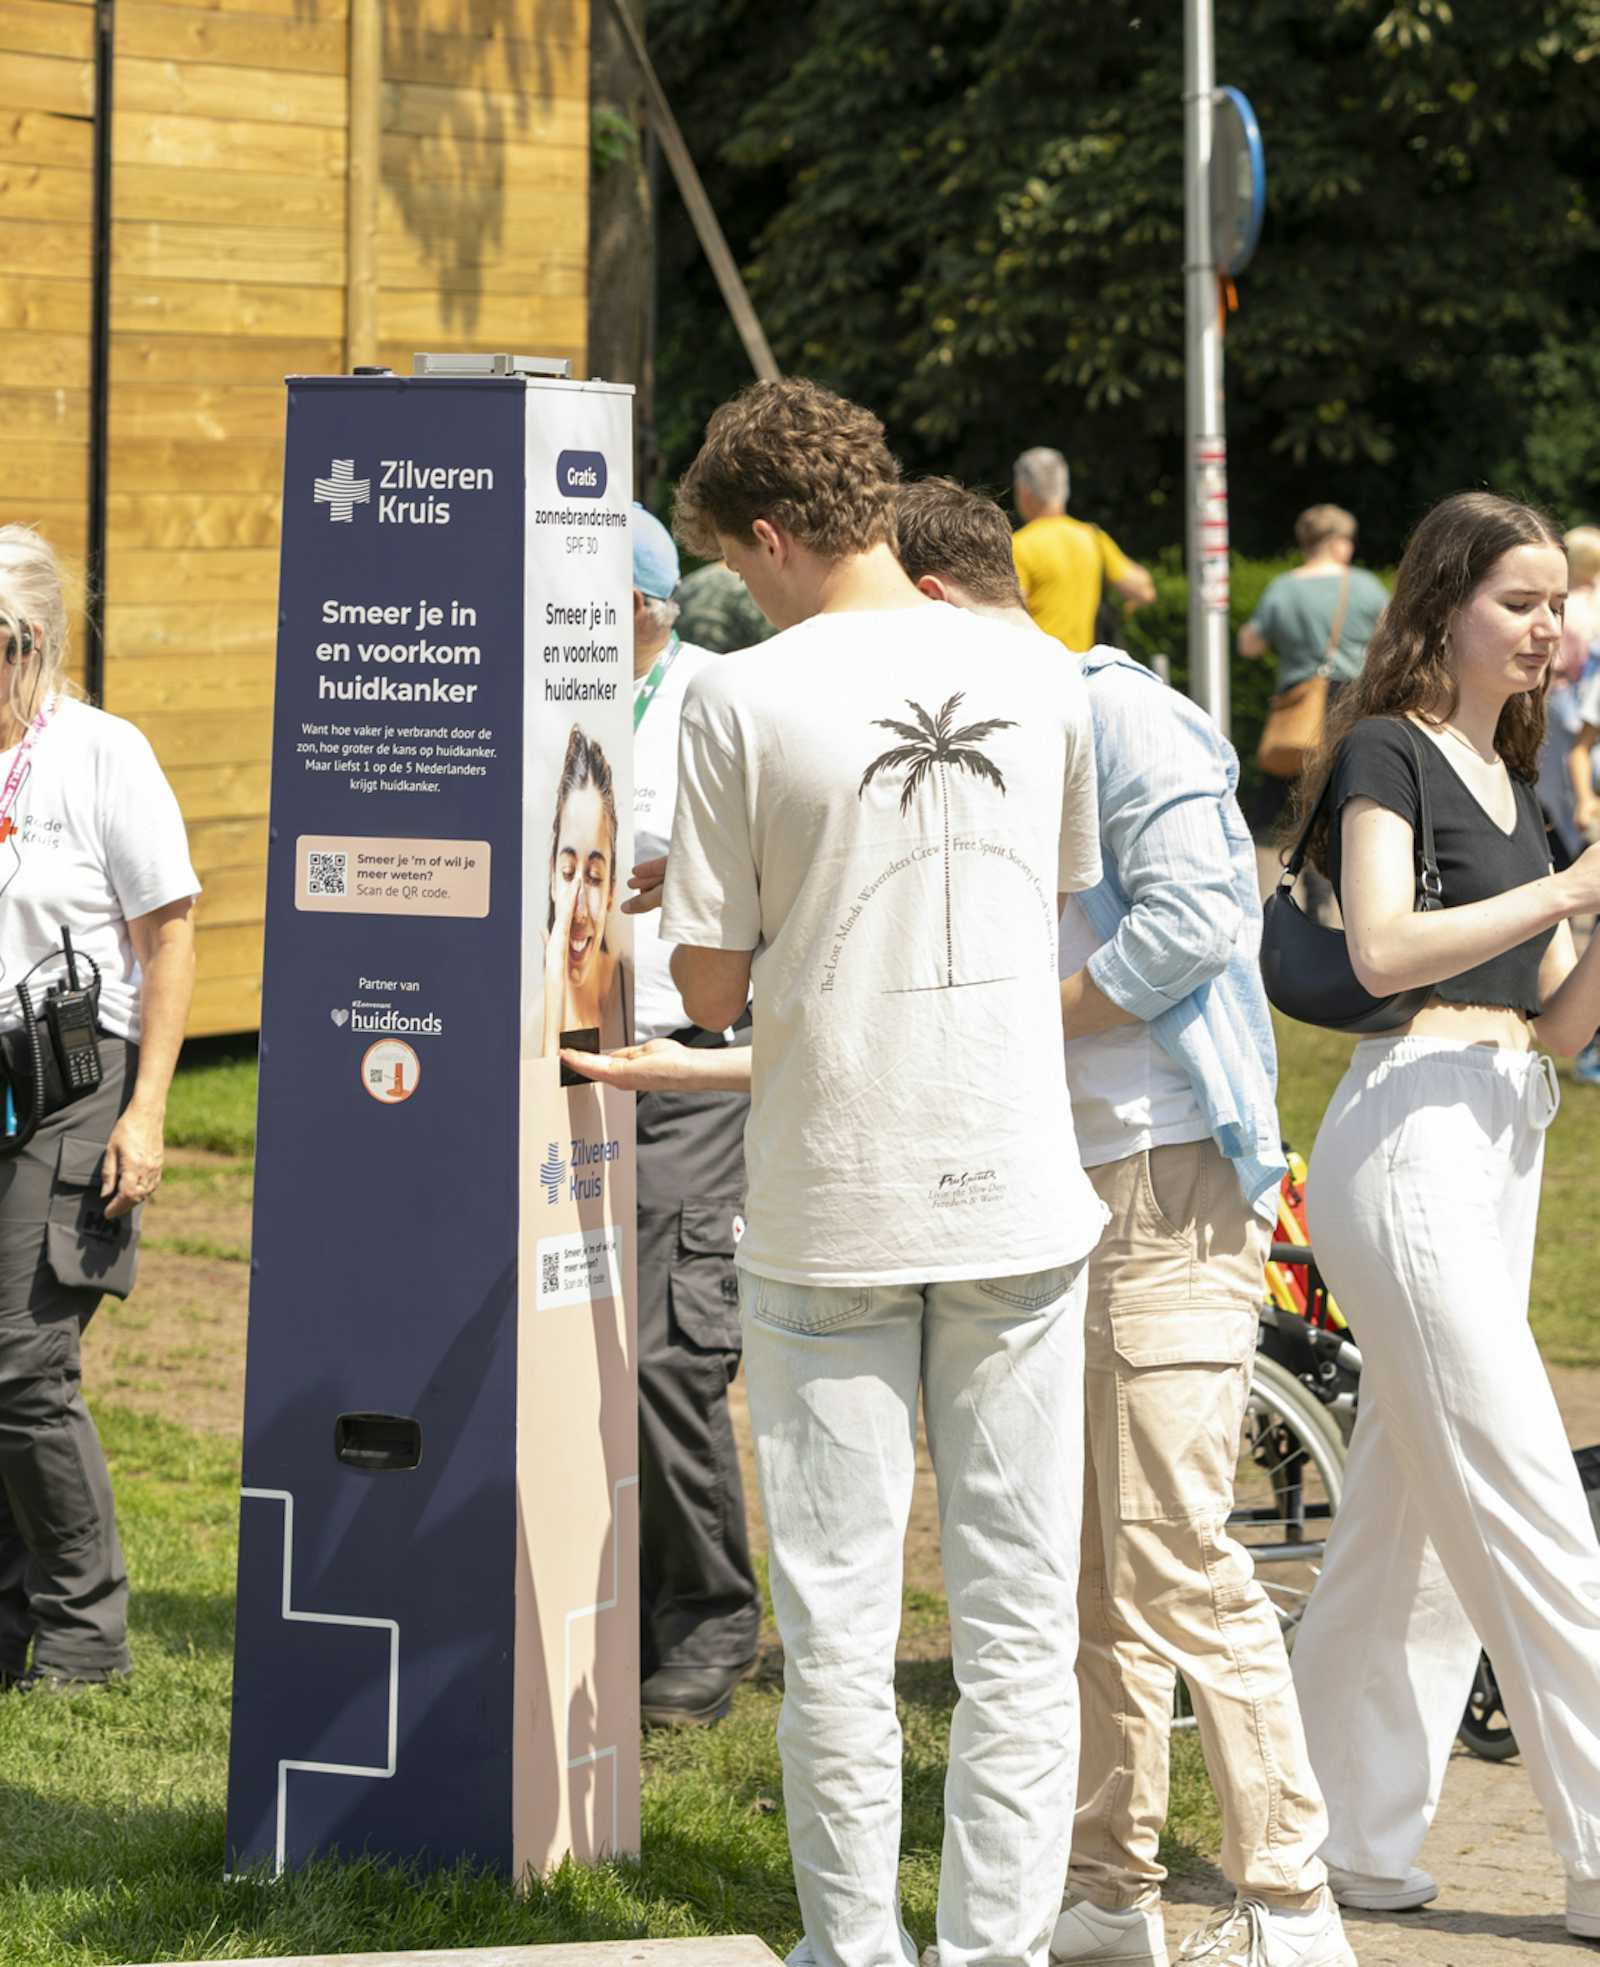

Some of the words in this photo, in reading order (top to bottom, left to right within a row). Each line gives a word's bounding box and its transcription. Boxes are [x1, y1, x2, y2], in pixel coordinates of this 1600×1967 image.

[380, 460, 494, 490] Zilveren
[567, 467, 598, 487] Gratis
[378, 495, 450, 524] Kruis
[535, 508, 627, 528] zonnebrandcrème
[566, 536, 583, 554] SPF
[587, 537, 598, 555] 30
[322, 600, 412, 625] Smeer
[415, 601, 444, 631] je
[451, 600, 476, 626] in
[545, 602, 587, 626] Smeer
[588, 603, 602, 631] je
[604, 603, 616, 625] in
[315, 642, 350, 662] en
[358, 639, 481, 665] voorkom
[543, 646, 559, 663] en
[563, 640, 618, 664] voorkom
[318, 675, 478, 703] huidkanker
[544, 677, 617, 701] huidkanker
[302, 723, 329, 736] Want
[331, 724, 351, 736] hoe
[353, 724, 382, 737] vaker
[384, 725, 394, 739] je
[397, 725, 448, 739] verbrandt
[450, 727, 475, 740] door
[478, 727, 492, 740] de
[296, 742, 318, 755] zon,
[319, 741, 339, 754] hoe
[342, 743, 374, 756] groter
[376, 743, 389, 755] de
[392, 743, 417, 756] kans
[420, 746, 433, 758] op
[436, 745, 497, 758] huidkanker.
[305, 759, 331, 771] Maar
[334, 759, 361, 772] liefst
[364, 761, 370, 772] 1
[373, 763, 387, 774] op
[389, 761, 402, 773] de
[405, 762, 412, 773] 5
[415, 761, 487, 776] Nederlanders
[350, 778, 378, 793] krijgt
[380, 779, 441, 792] huidkanker.
[24, 815, 62, 833] Rde
[953, 837, 977, 851] Free
[979, 838, 1007, 858] Spirit
[357, 854, 395, 866] Smeer
[397, 855, 409, 868] je
[429, 854, 442, 867] of
[444, 855, 462, 867] wil
[464, 856, 476, 870] je
[911, 846, 941, 863] Crew
[357, 869, 388, 879] meer
[390, 870, 433, 881] weten?
[356, 884, 382, 896] Scan
[385, 885, 399, 898] de
[402, 885, 418, 899] QR
[421, 886, 451, 899] code.
[835, 904, 864, 942] Minds
[824, 943, 843, 972] Lost
[359, 976, 398, 991] Partner
[400, 981, 420, 992] van
[821, 971, 835, 994] The
[352, 1009, 442, 1033] huidfonds
[570, 1138, 619, 1168] Zilveren
[569, 1172, 602, 1201] Kruis
